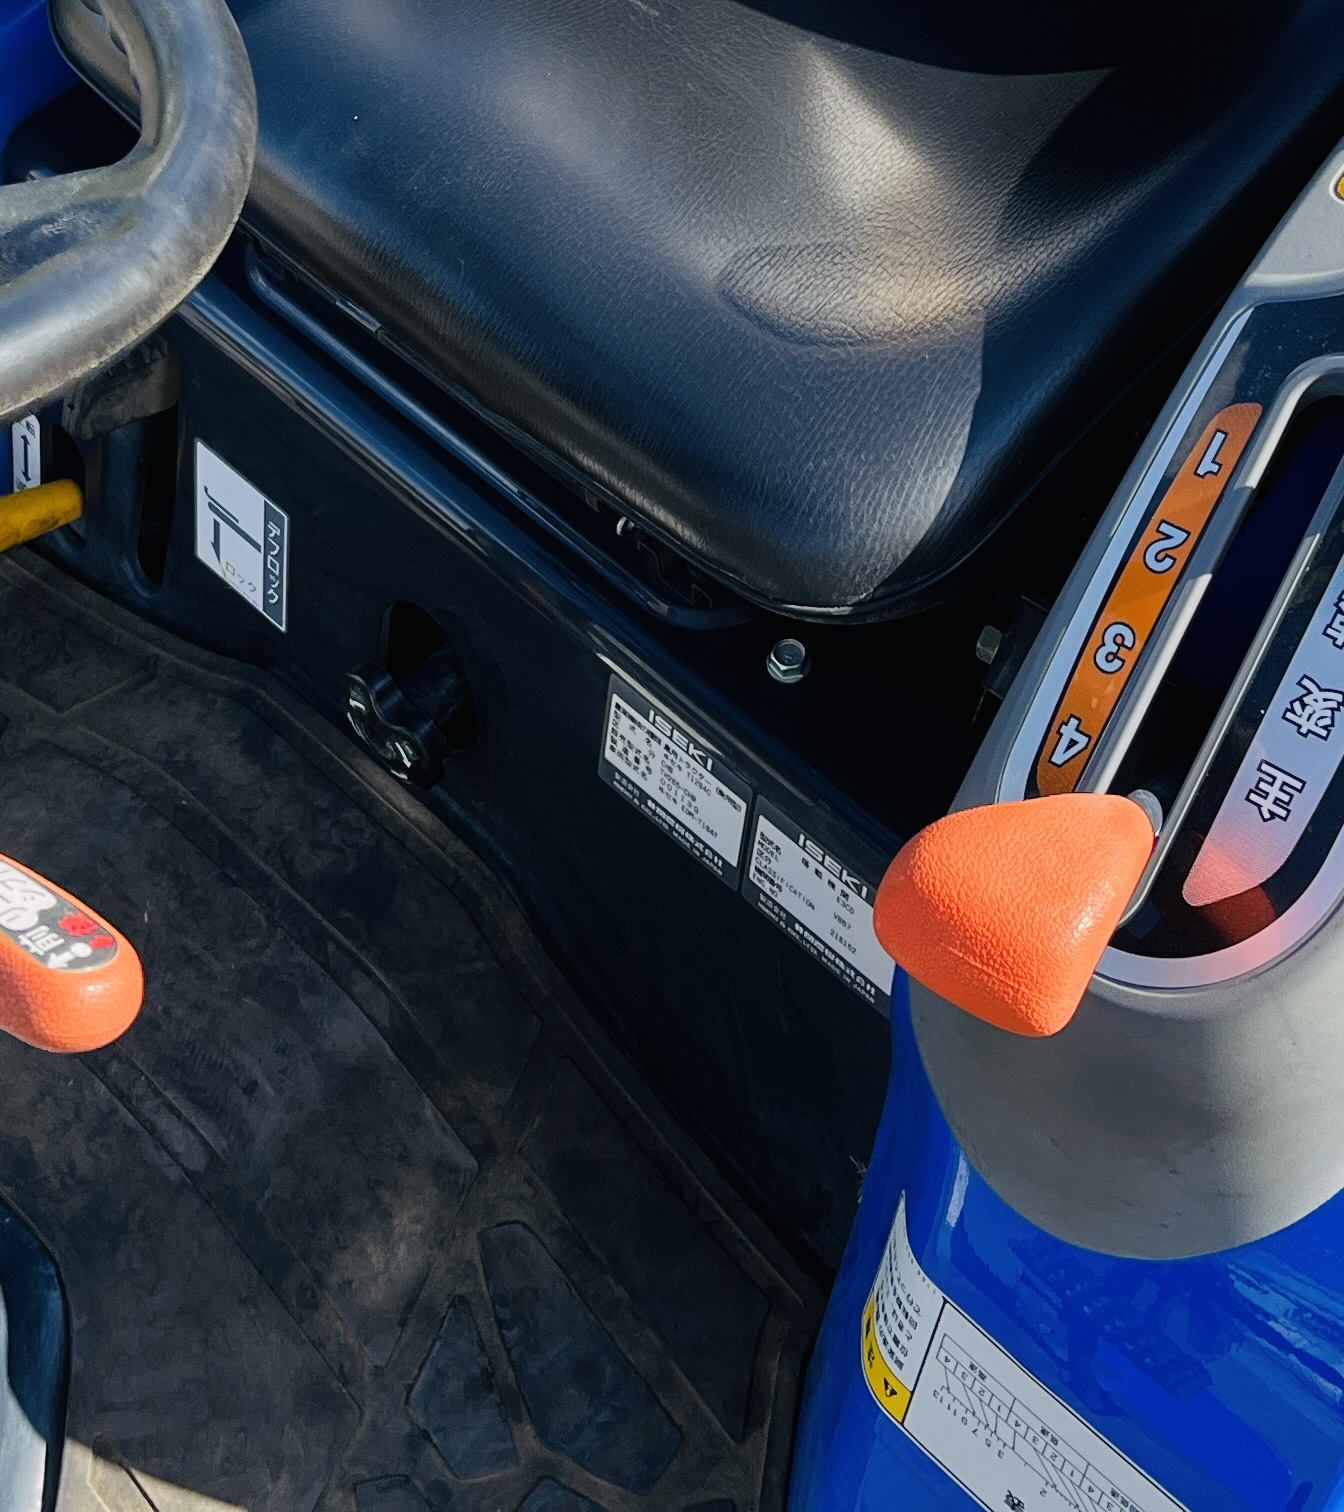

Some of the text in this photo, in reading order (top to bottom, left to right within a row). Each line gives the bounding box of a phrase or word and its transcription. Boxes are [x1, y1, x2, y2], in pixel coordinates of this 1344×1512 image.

[1194, 429, 1229, 479] 1
[267, 521, 281, 605] デフロック
[1143, 521, 1189, 575] 2
[225, 560, 257, 593] ロック
[1093, 619, 1136, 674] 3
[649, 710, 713, 771] ISEKI
[1048, 715, 1091, 766] 4
[799, 833, 868, 899] ISEKI
[17, 925, 65, 956] 前
